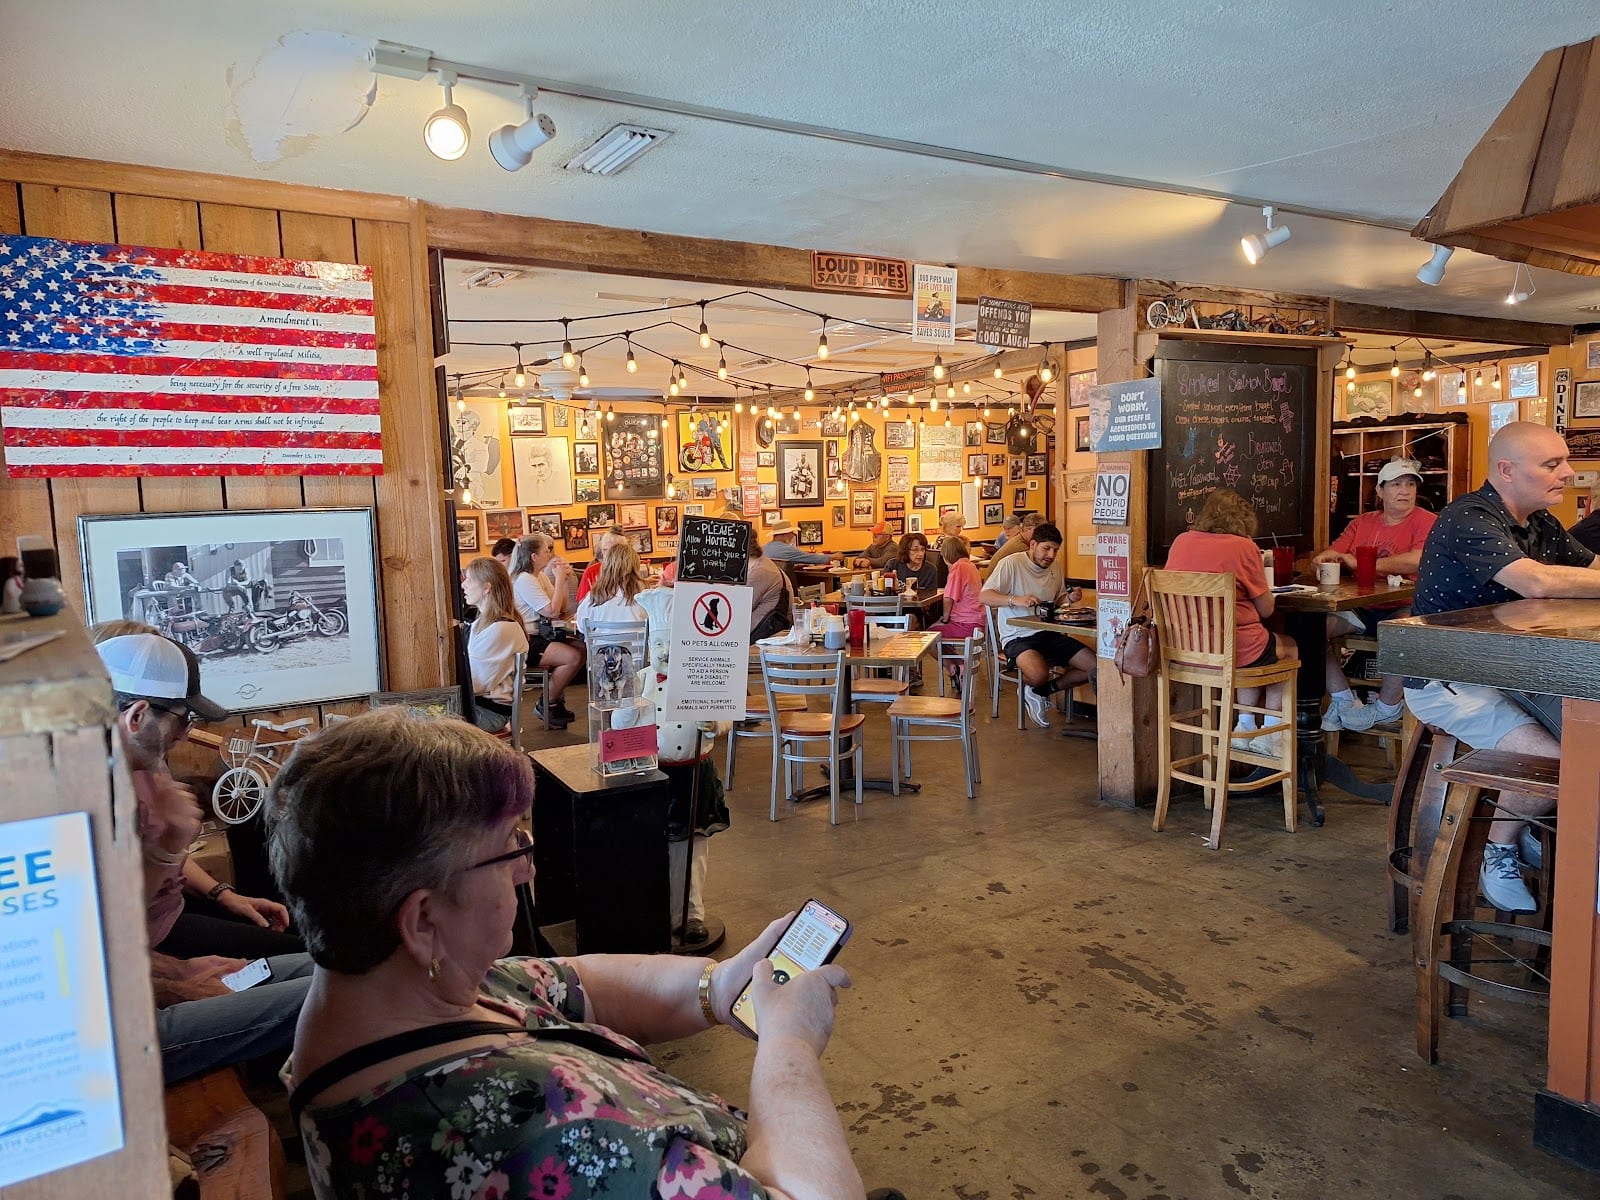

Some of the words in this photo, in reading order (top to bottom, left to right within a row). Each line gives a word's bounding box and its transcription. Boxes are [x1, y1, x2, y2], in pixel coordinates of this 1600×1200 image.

[817, 256, 859, 273] LOUD
[864, 261, 904, 278] PIPES
[817, 272, 858, 286] SAVE
[863, 276, 905, 289] LIVES
[259, 312, 310, 326] Amendment
[979, 305, 1013, 321] OFFENDS
[1014, 309, 1031, 323] YOU
[916, 327, 933, 337] SAVES
[933, 328, 952, 339] SOULS
[977, 329, 1000, 344] GOOD
[1001, 333, 1029, 348] LAUGH
[246, 347, 262, 357] well
[264, 349, 294, 360] regulated
[169, 377, 187, 391] being
[189, 378, 221, 392] necessary
[220, 379, 233, 391] for
[234, 379, 244, 389] the
[246, 381, 273, 393] security
[274, 381, 282, 393] of
[288, 382, 302, 393] free
[1228, 367, 1262, 393] Salmon
[1120, 390, 1145, 403] DON'T
[1117, 401, 1149, 414] WORRY,
[1555, 384, 1567, 434] DINER
[96, 412, 107, 422] the
[110, 414, 127, 426] right
[129, 413, 137, 426] of
[138, 413, 149, 423] the
[152, 414, 174, 428] people
[175, 416, 183, 424] to
[184, 414, 200, 428] keep
[201, 415, 216, 425] and
[217, 416, 232, 425] bear
[254, 415, 272, 426] shall
[286, 416, 293, 425] be
[1114, 415, 1127, 424] OUR
[1127, 413, 1144, 423] STAFF
[1145, 413, 1151, 421] IS
[1109, 423, 1147, 433] ACCUSTOMED
[1147, 421, 1156, 430] TO
[1108, 433, 1126, 442] DUMB
[1126, 431, 1158, 442] QUESTIONS
[1096, 474, 1128, 497] NO
[1095, 497, 1126, 508] STUPID
[1093, 508, 1126, 518] PEOPLE
[701, 523, 735, 536] PLEASE
[705, 535, 737, 549] HOSTESS
[1098, 535, 1128, 545] BEWARE
[690, 545, 699, 556] to
[1108, 545, 1118, 554] OF
[1105, 570, 1121, 580] JUST
[1100, 580, 1127, 591] BEWARE
